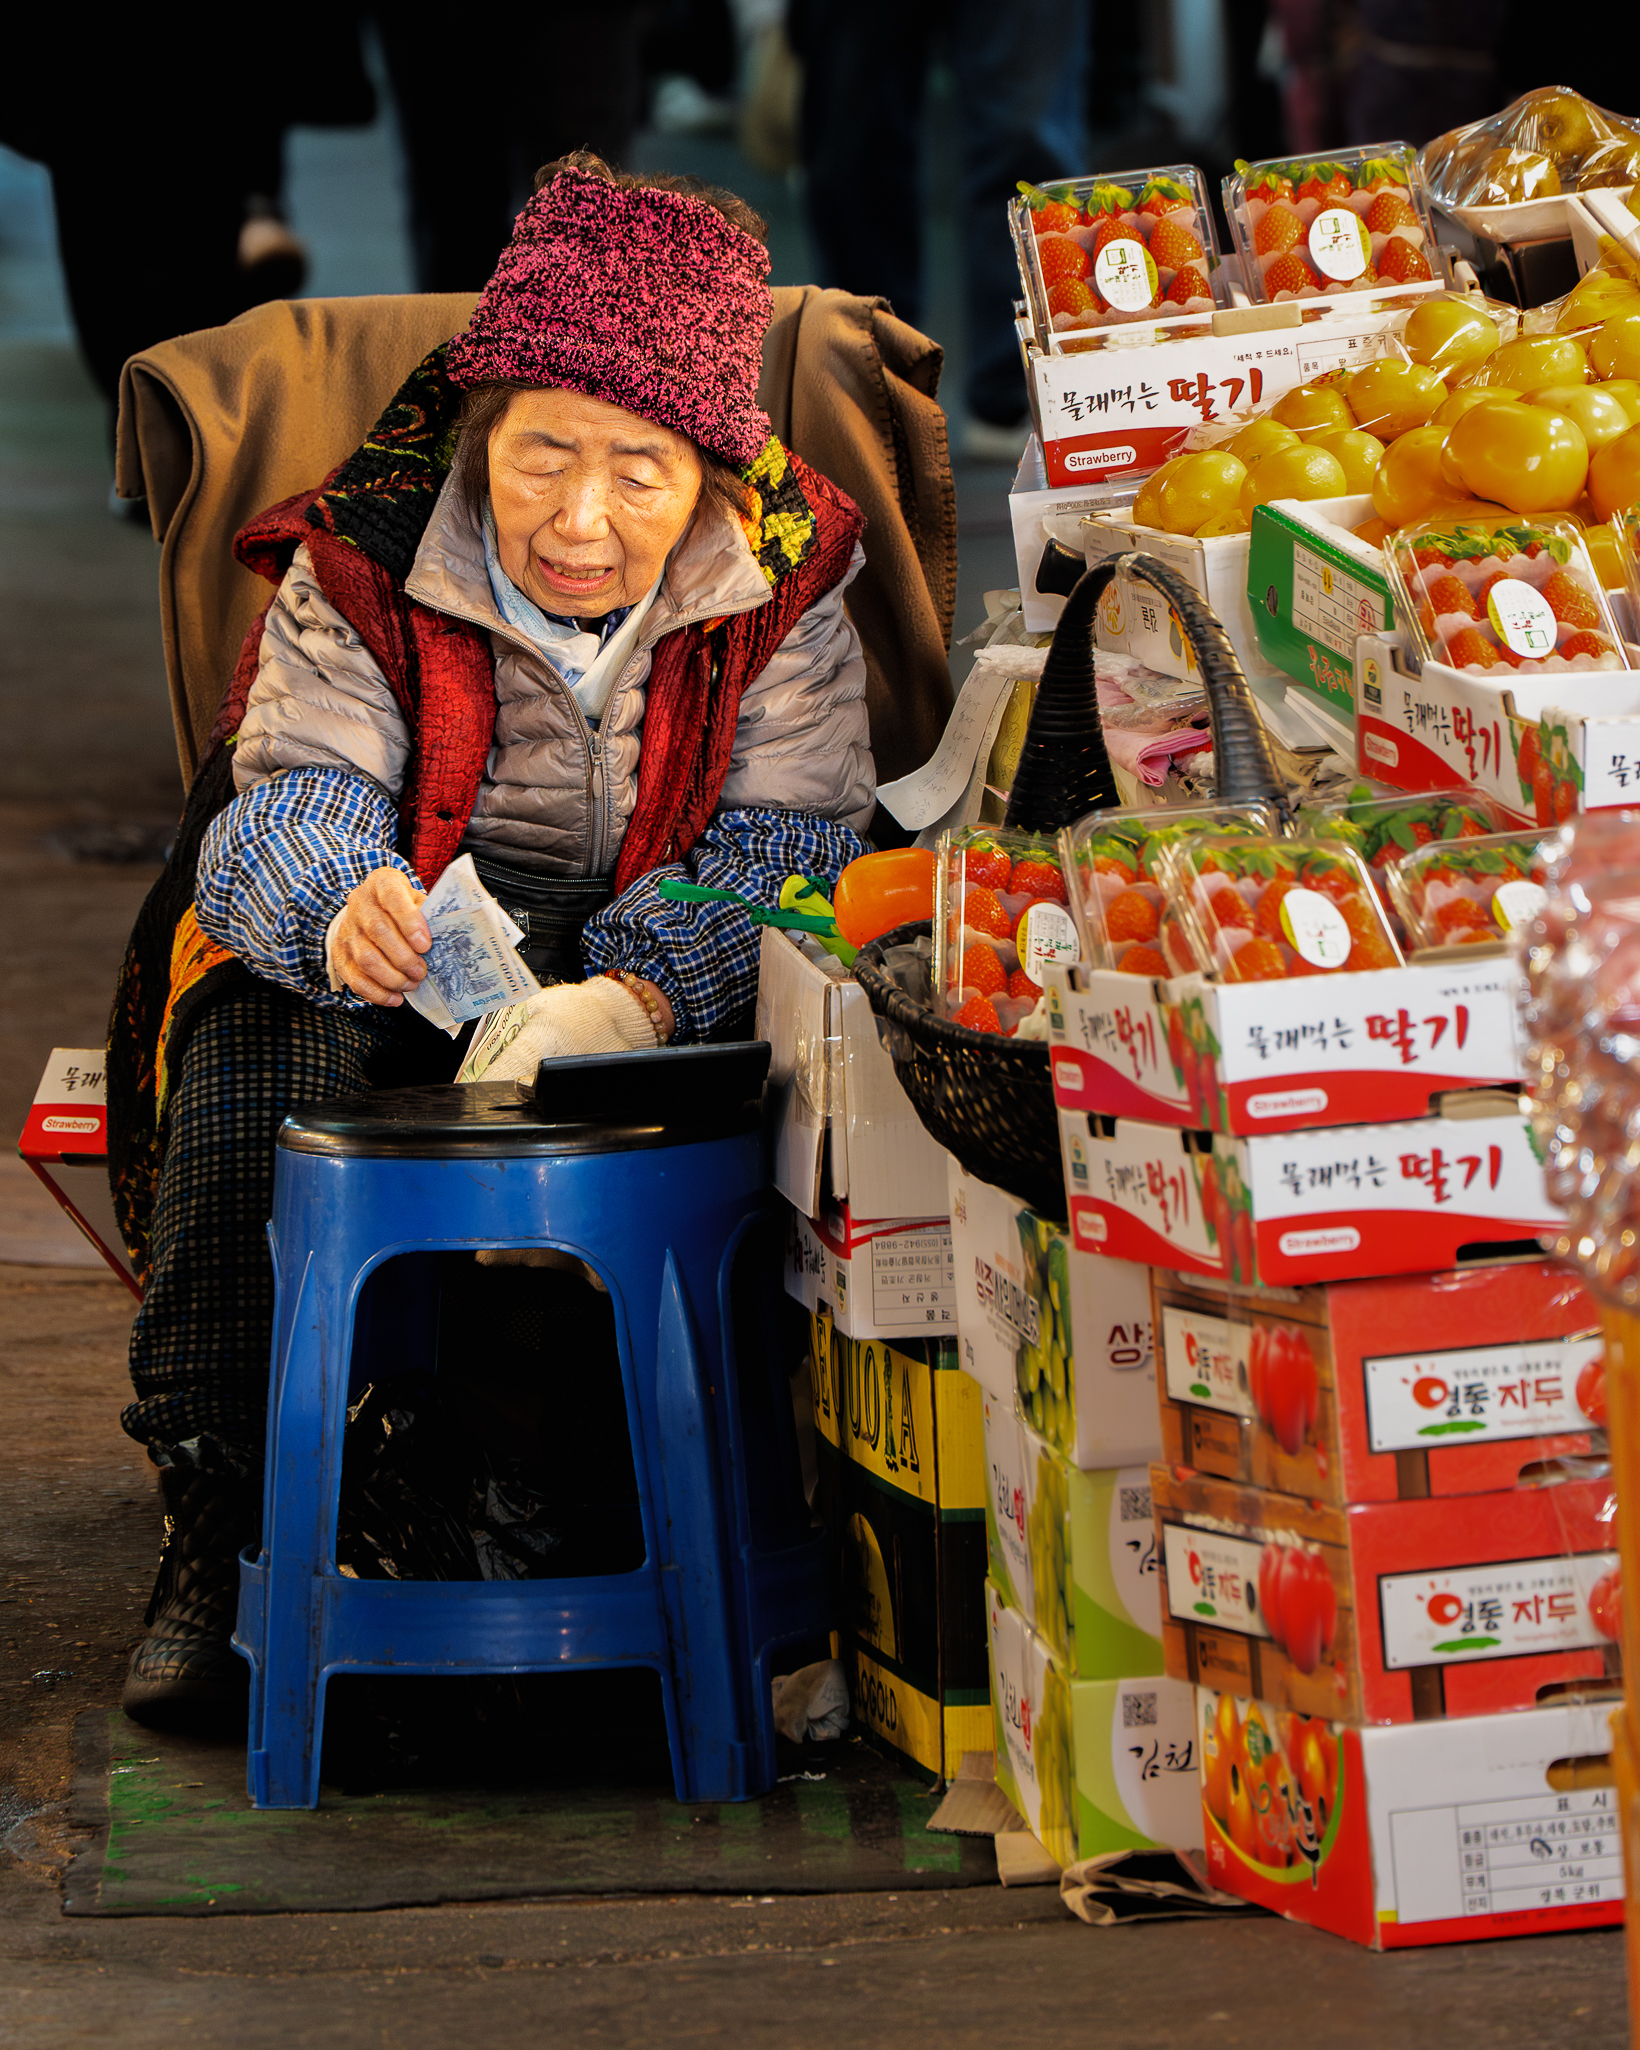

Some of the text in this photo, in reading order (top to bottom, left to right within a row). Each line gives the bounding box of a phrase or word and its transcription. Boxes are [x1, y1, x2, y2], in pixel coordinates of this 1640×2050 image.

[1060, 367, 1263, 421] 몰래먹는 딸기
[1069, 448, 1133, 467] Strawberry
[1403, 691, 1451, 746] 몰래먹는
[1452, 706, 1500, 781] 딸기
[486, 1030, 502, 1051] won
[1114, 1005, 1157, 1081] 딸기
[1247, 1004, 1469, 1065] 몰래먹는 딸기
[45, 1118, 97, 1132] Strawberry
[1280, 1144, 1502, 1205] 몰래먹는 딸기
[1145, 1158, 1189, 1235] 딸기
[875, 1238, 939, 1250] (055)942-9884
[1107, 1322, 1154, 1364] 상
[1498, 1375, 1564, 1409] 자두
[1511, 1591, 1577, 1625] 자두
[1128, 1738, 1199, 1782] 김천
